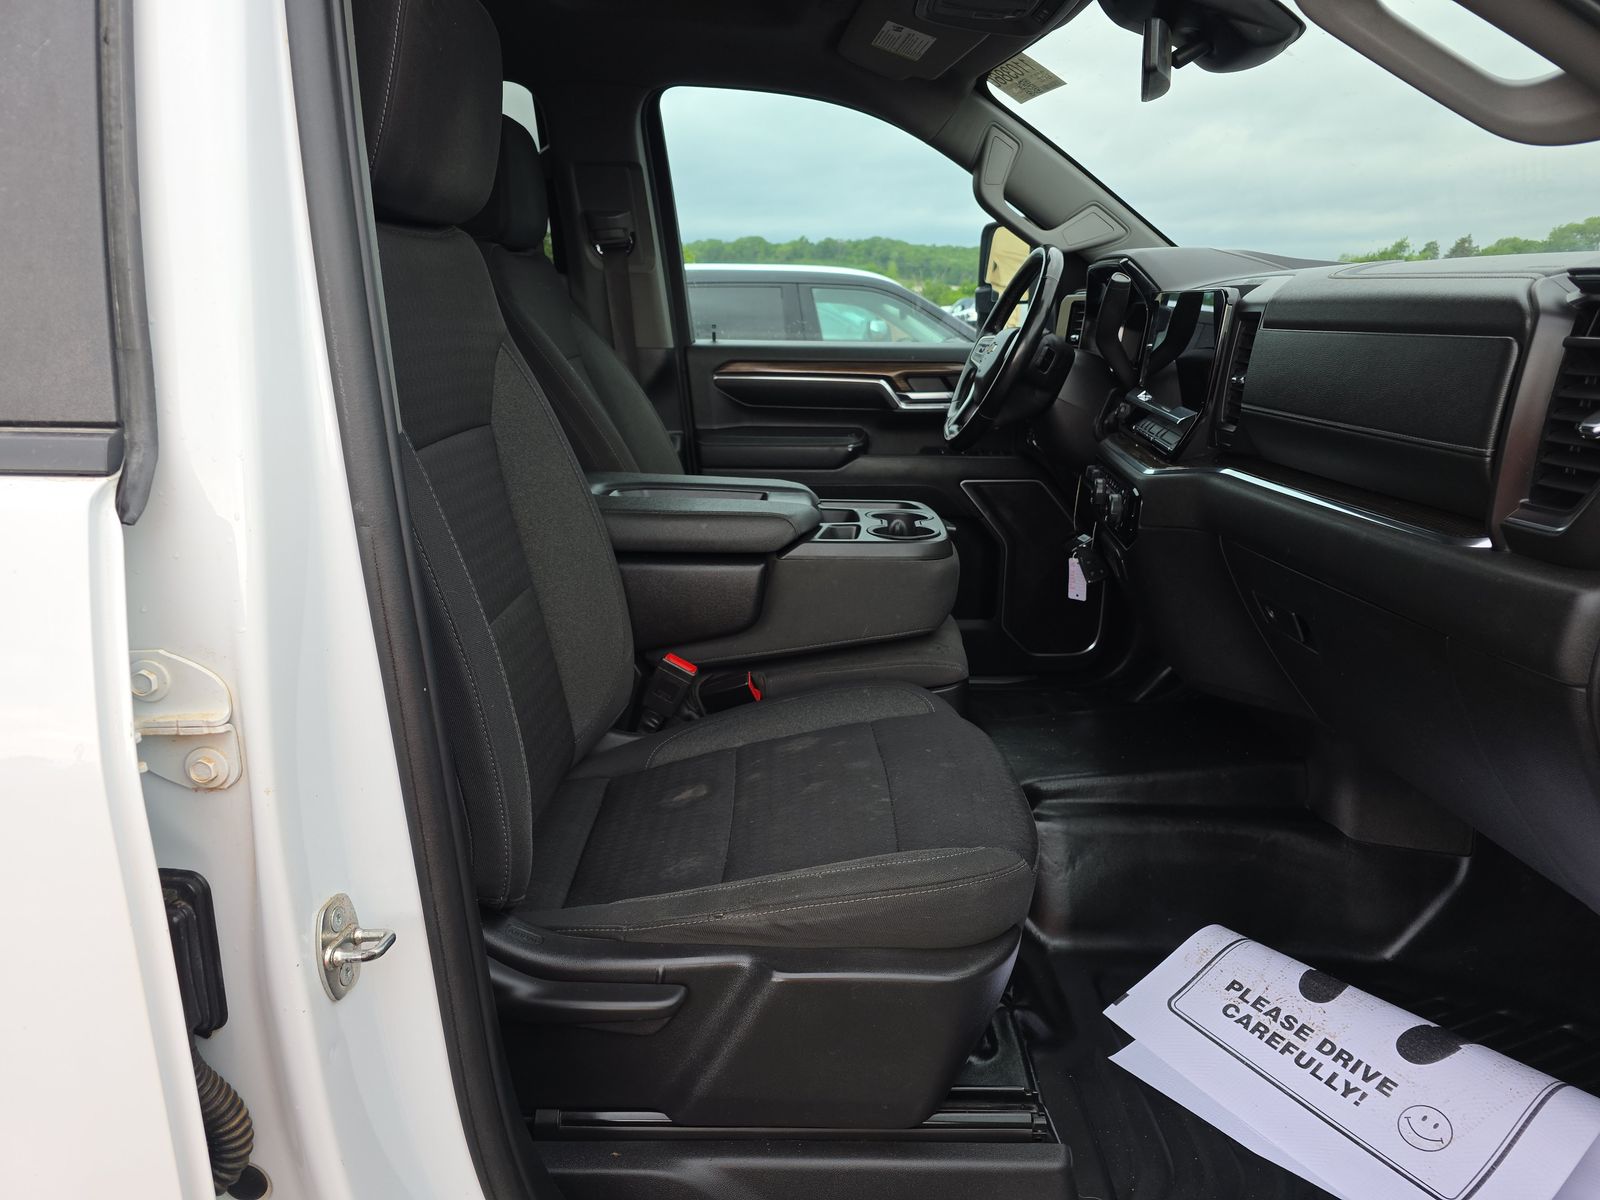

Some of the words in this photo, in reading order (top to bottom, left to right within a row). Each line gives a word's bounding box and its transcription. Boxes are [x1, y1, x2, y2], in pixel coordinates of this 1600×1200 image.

[1222, 1003, 1369, 1107] CAREFULLY!
[1224, 979, 1315, 1042] PLEASE
[1315, 1037, 1399, 1098] DRIVE
